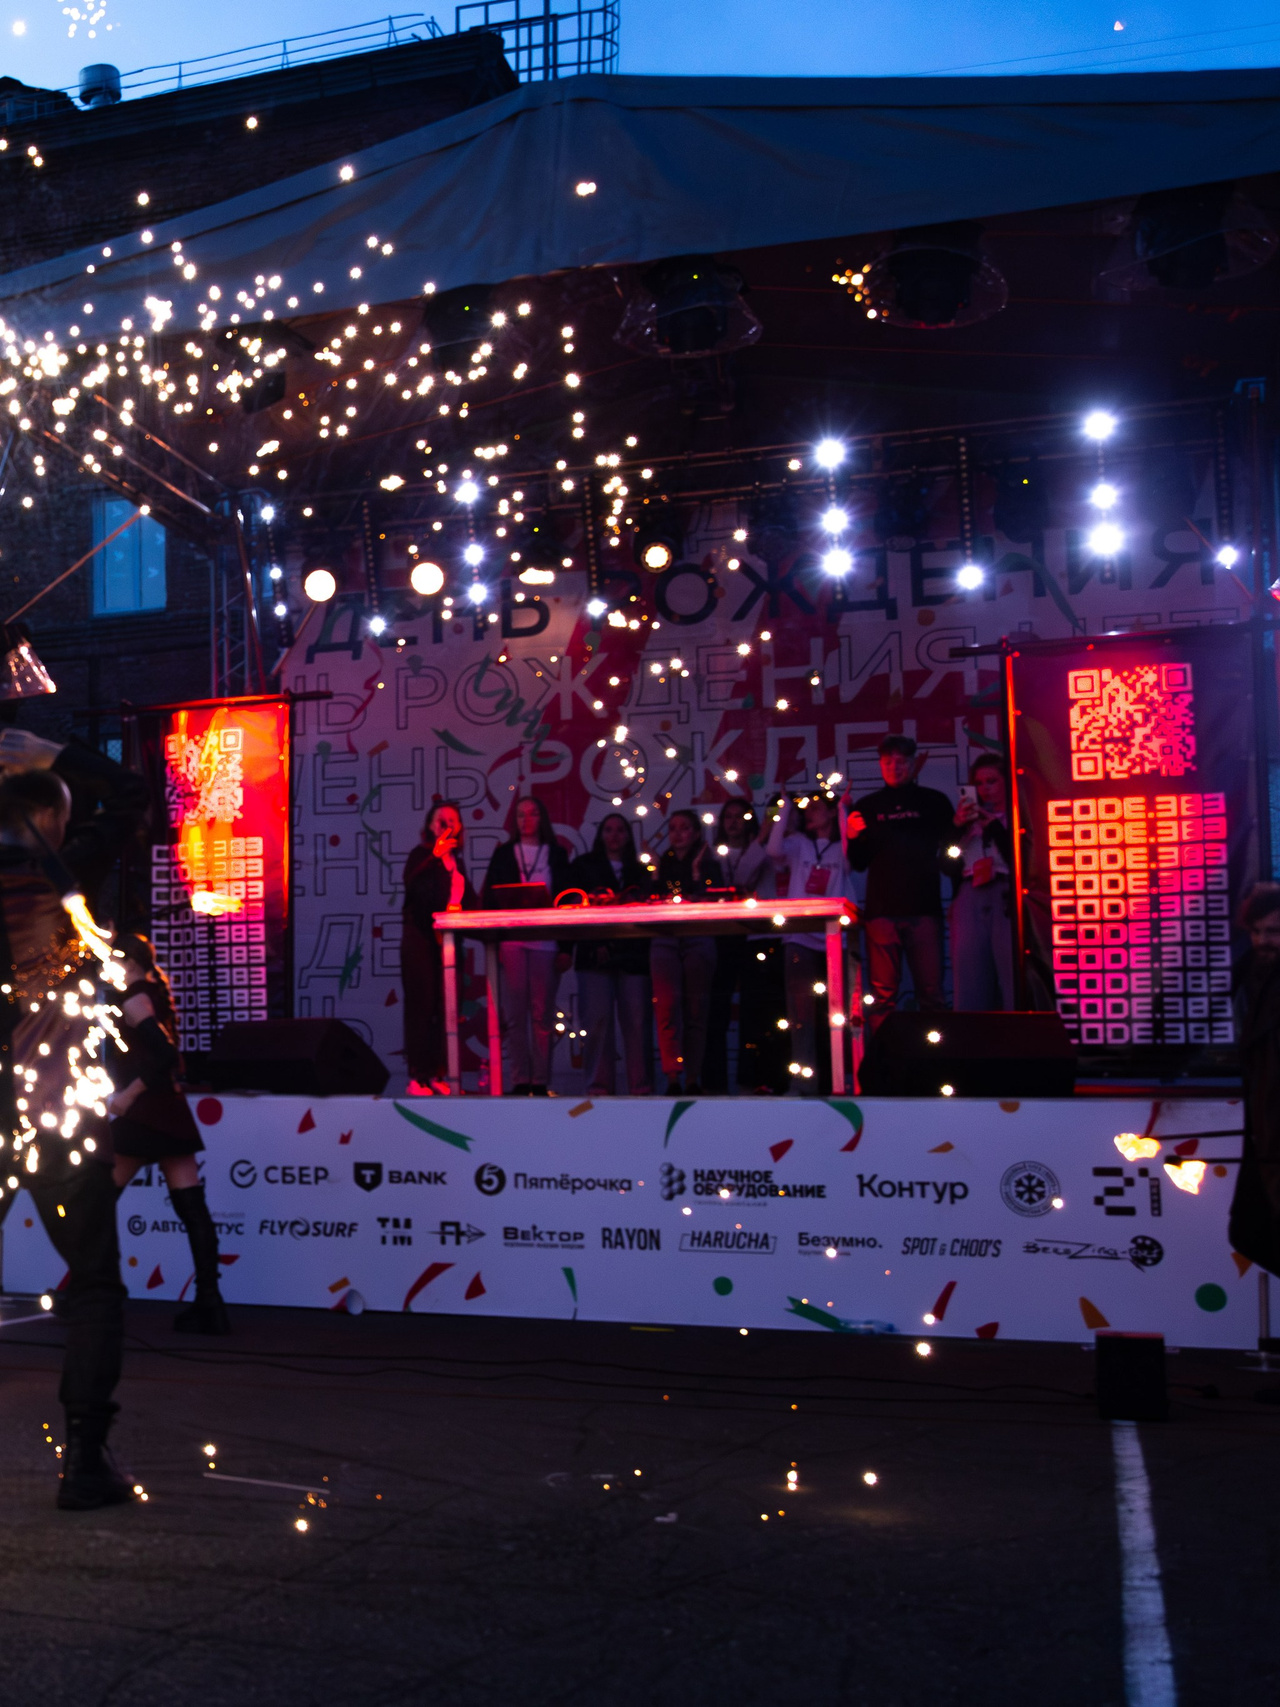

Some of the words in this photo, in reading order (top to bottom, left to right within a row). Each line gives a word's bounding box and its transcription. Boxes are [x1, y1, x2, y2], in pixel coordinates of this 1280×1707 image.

[396, 626, 978, 731] РОЖДЕНИЯ
[1049, 843, 1229, 872] CODE.383
[1050, 868, 1229, 896] CODE.383
[1051, 893, 1230, 921] CODE.383
[152, 923, 266, 948] CODE.383
[1052, 919, 1231, 945] CODE.383
[1053, 945, 1232, 970] CODE.383
[165, 965, 267, 991] ODE.383
[1054, 970, 1233, 995] CODE.383
[171, 987, 268, 1011] ODE.383
[1055, 995, 1234, 1019] CODE.383
[264, 1166, 329, 1185] СБЕР
[388, 1170, 447, 1186] BANK
[514, 1172, 633, 1195] Пятёрочка
[693, 1168, 773, 1184] НАУЧНОЕ
[855, 1173, 969, 1205] Контур
[601, 1227, 661, 1251] RAYON
[689, 1230, 771, 1250] HARUCHA
[797, 1231, 883, 1249] Безумно.
[901, 1237, 938, 1256] SPOT
